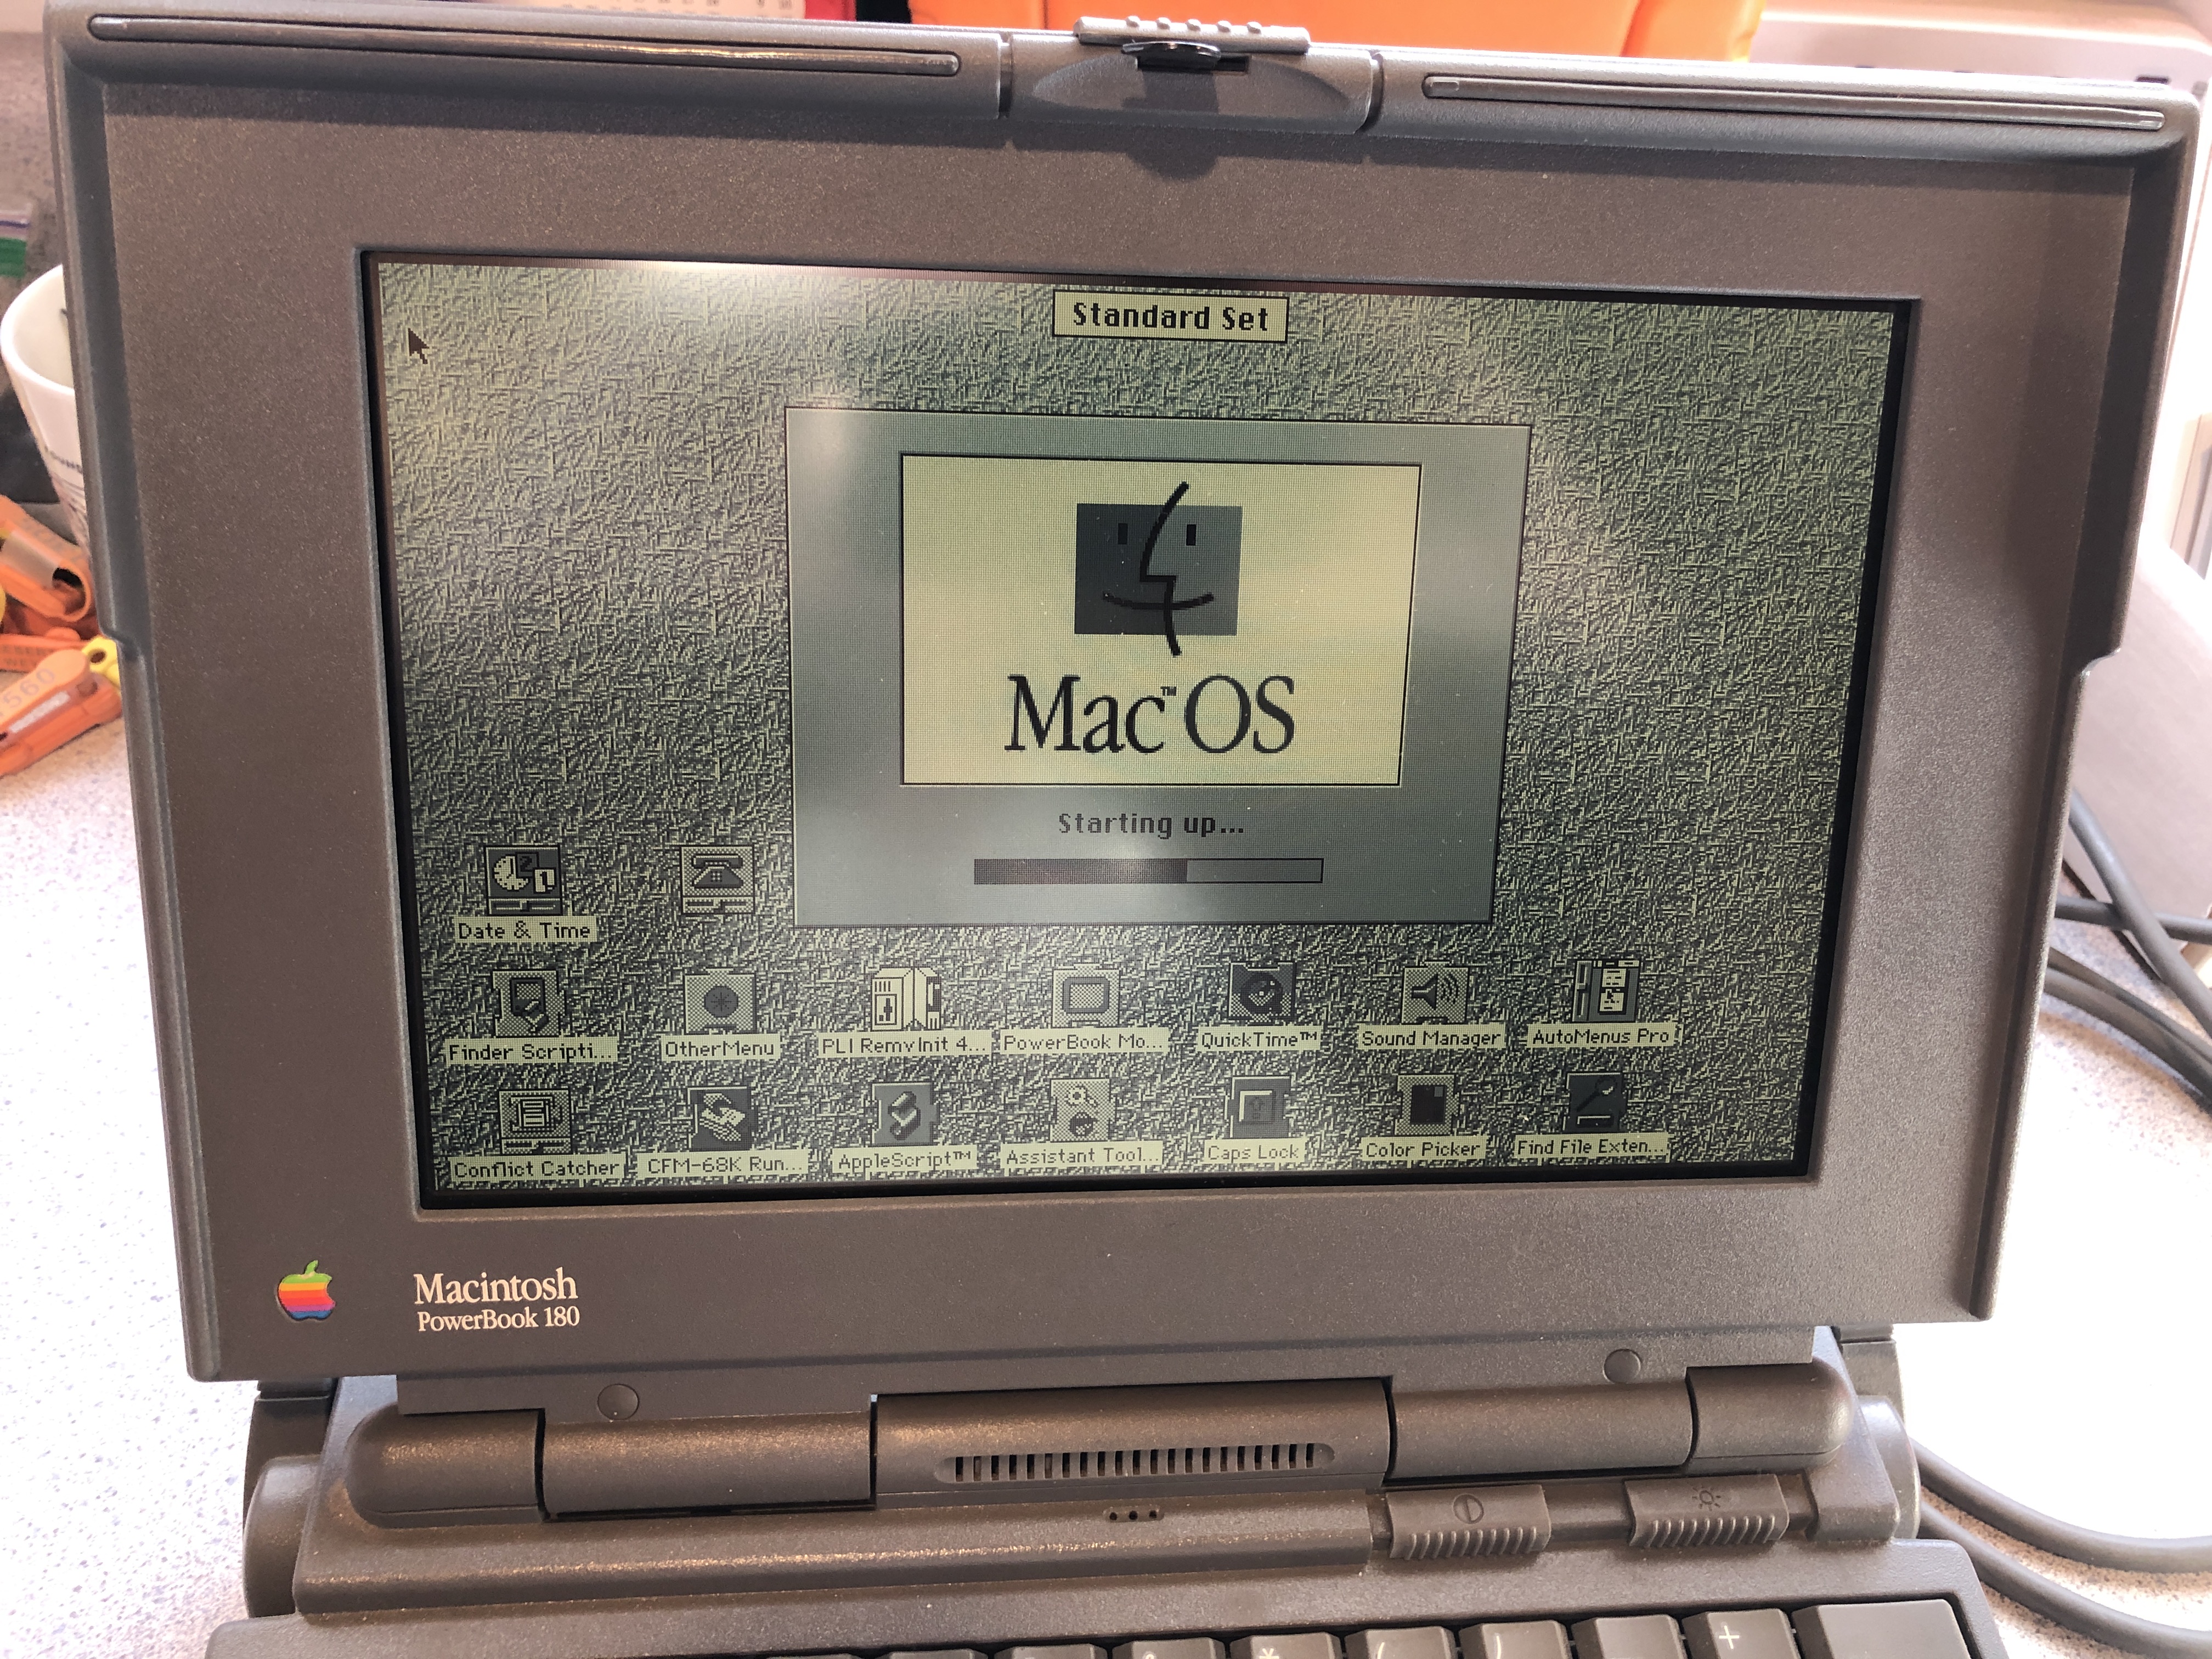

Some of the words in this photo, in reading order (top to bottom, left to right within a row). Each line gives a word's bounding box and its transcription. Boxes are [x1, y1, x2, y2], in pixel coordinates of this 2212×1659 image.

[1074, 302, 1210, 330] Standard
[1223, 307, 1268, 331] Set
[1184, 675, 1295, 753] OS
[1059, 814, 1172, 839] Starting
[459, 922, 506, 939] Date
[514, 921, 532, 939] &
[540, 921, 590, 938] Time
[1004, 1035, 1111, 1051] PowerBook
[1362, 1031, 1417, 1046] Sound
[1424, 1030, 1500, 1048] Manager
[1534, 1028, 1630, 1044] AutoMenus
[1638, 1028, 1669, 1043] Pro
[449, 1043, 514, 1060] Finder
[665, 1041, 774, 1058] OtherMenu
[823, 1038, 854, 1053] PLI
[1208, 1147, 1250, 1163] Caps
[1259, 1144, 1299, 1159] Lock
[1366, 1142, 1411, 1157] Color
[1422, 1141, 1480, 1156] Picker
[1517, 1141, 1554, 1155] Find
[1560, 1140, 1592, 1154] File
[648, 1157, 741, 1173] CFM-68K
[1006, 1149, 1096, 1164] Assistant
[454, 1160, 534, 1178] Conflict
[539, 1160, 620, 1176] Catcher
[413, 1267, 578, 1305] Macintosh
[417, 1307, 538, 1331] PowerBook
[544, 1306, 580, 1327] 180
